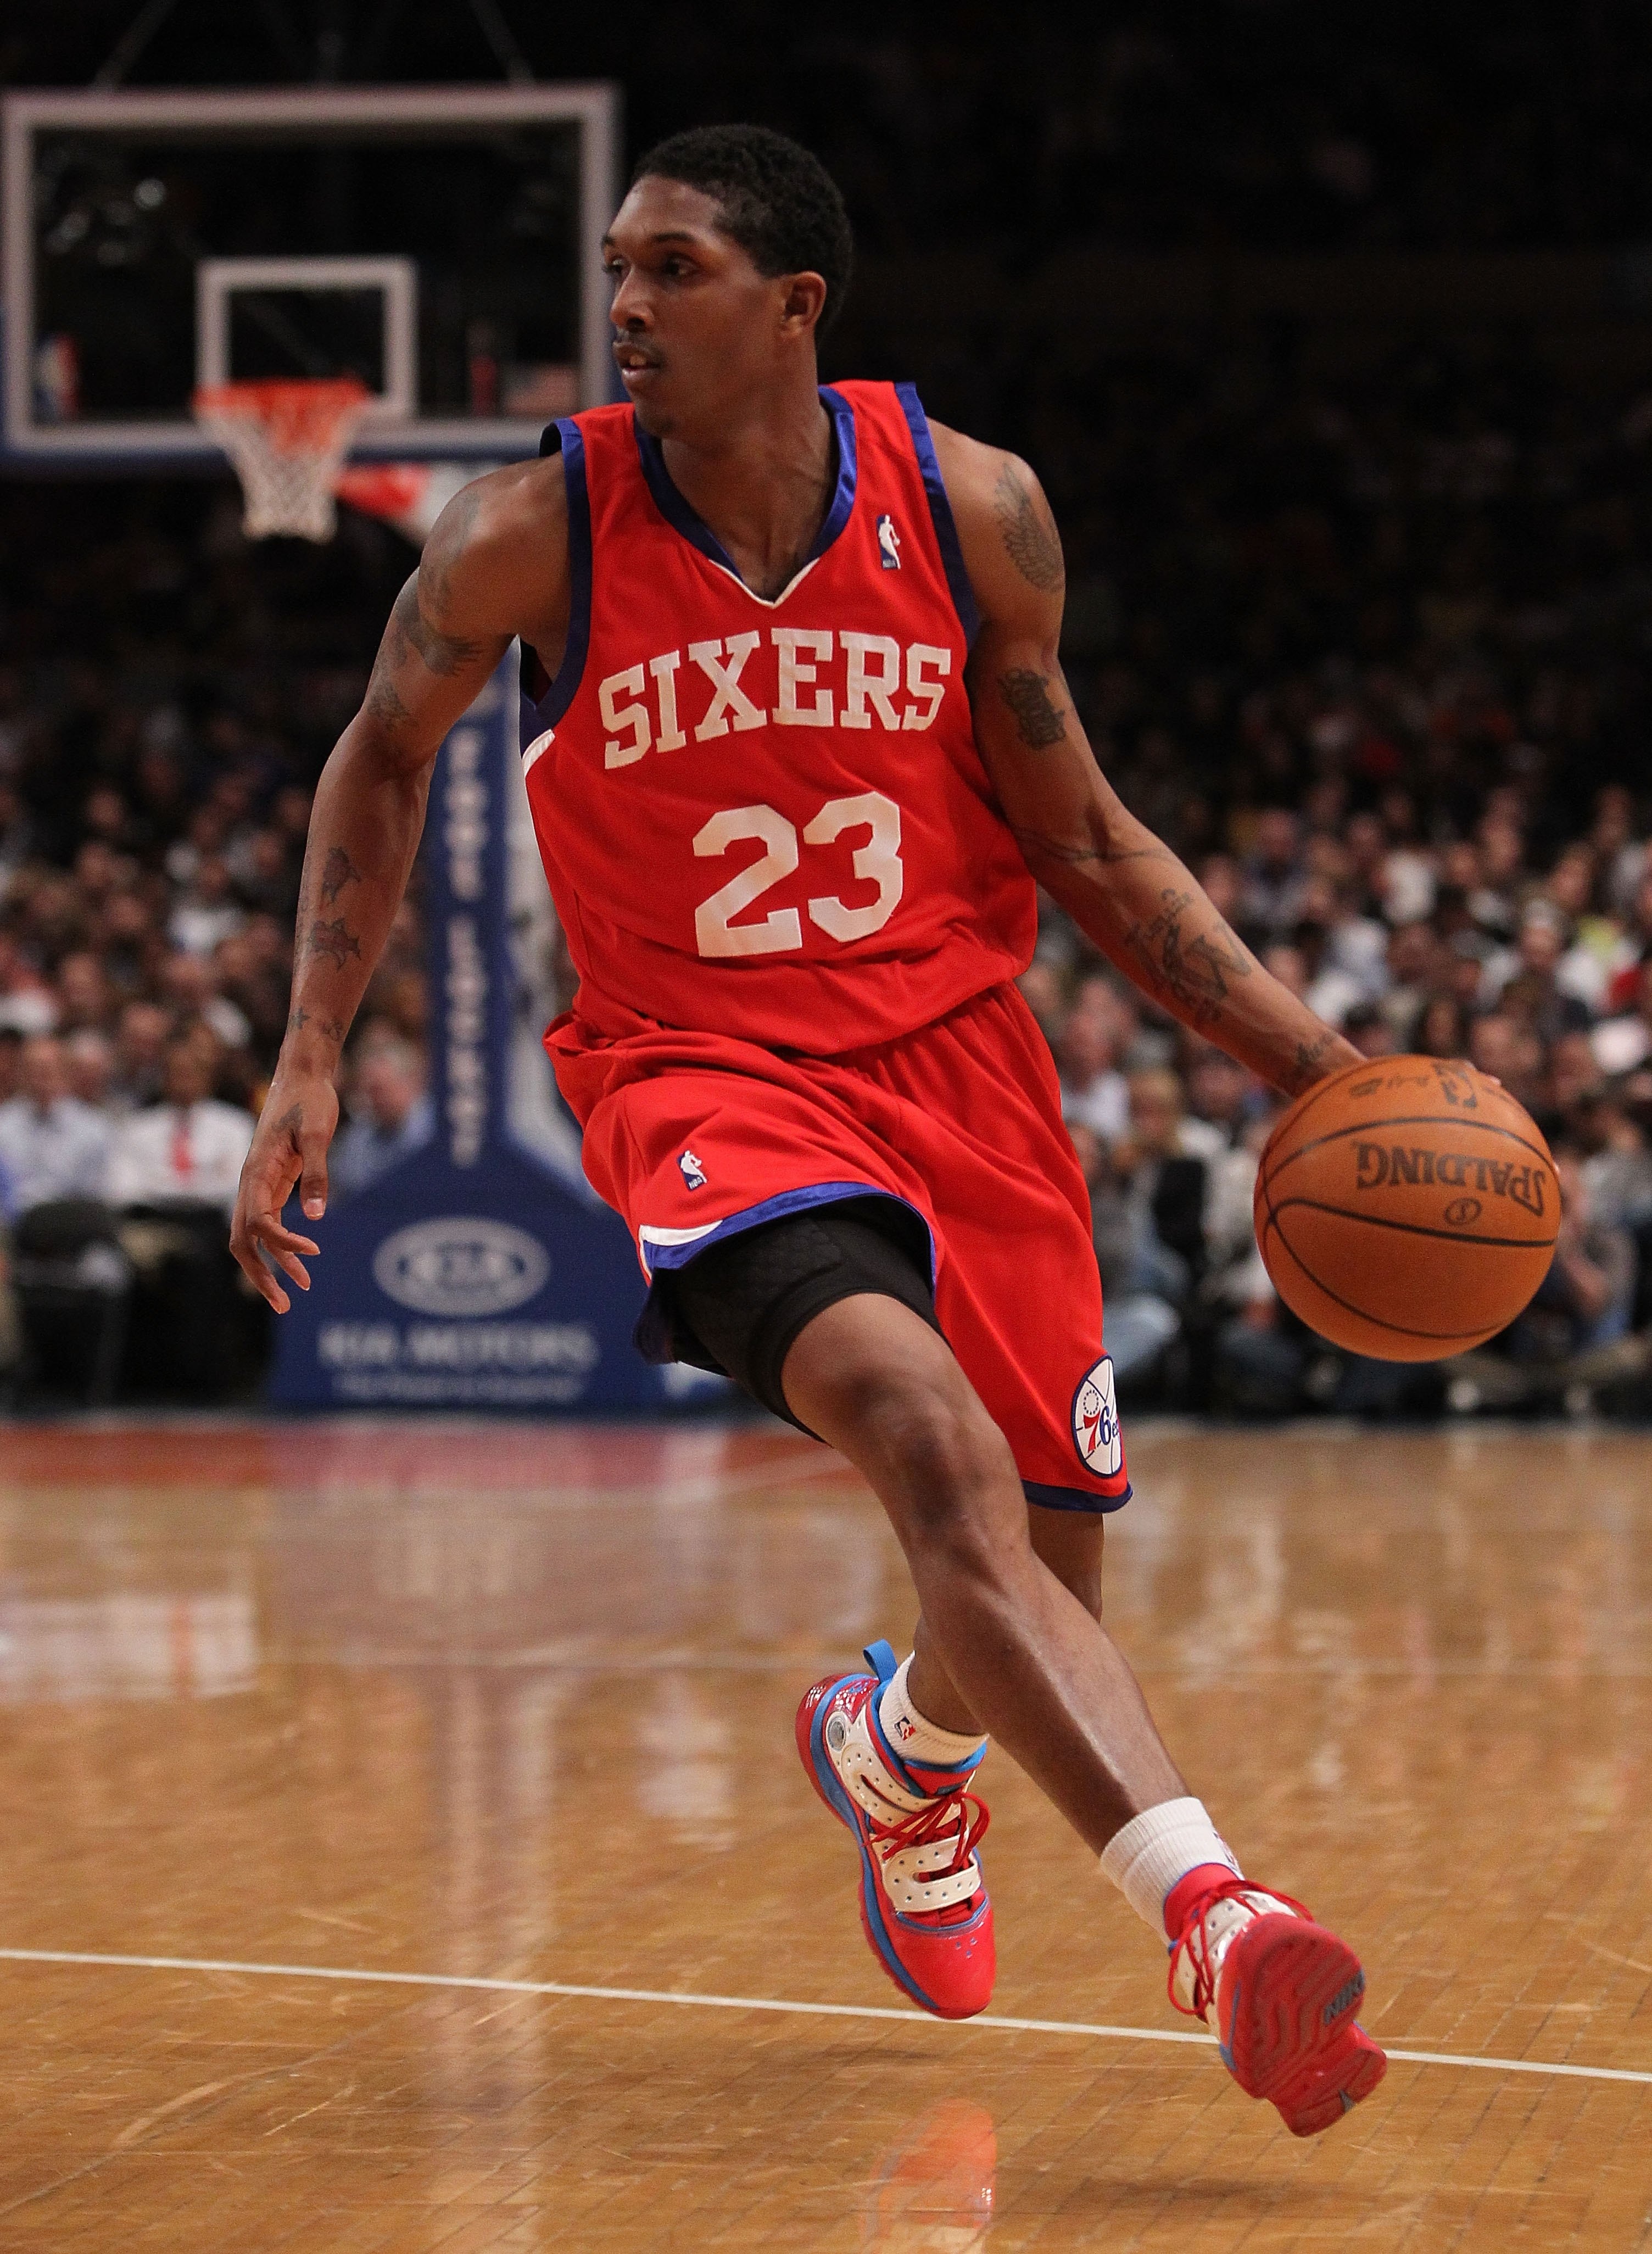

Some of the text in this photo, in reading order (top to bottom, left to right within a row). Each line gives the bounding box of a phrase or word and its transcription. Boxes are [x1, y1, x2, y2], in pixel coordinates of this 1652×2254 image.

[598, 627, 951, 769] SIXERS
[692, 791, 903, 958] 23
[1354, 1142, 1546, 1218] SPALDING
